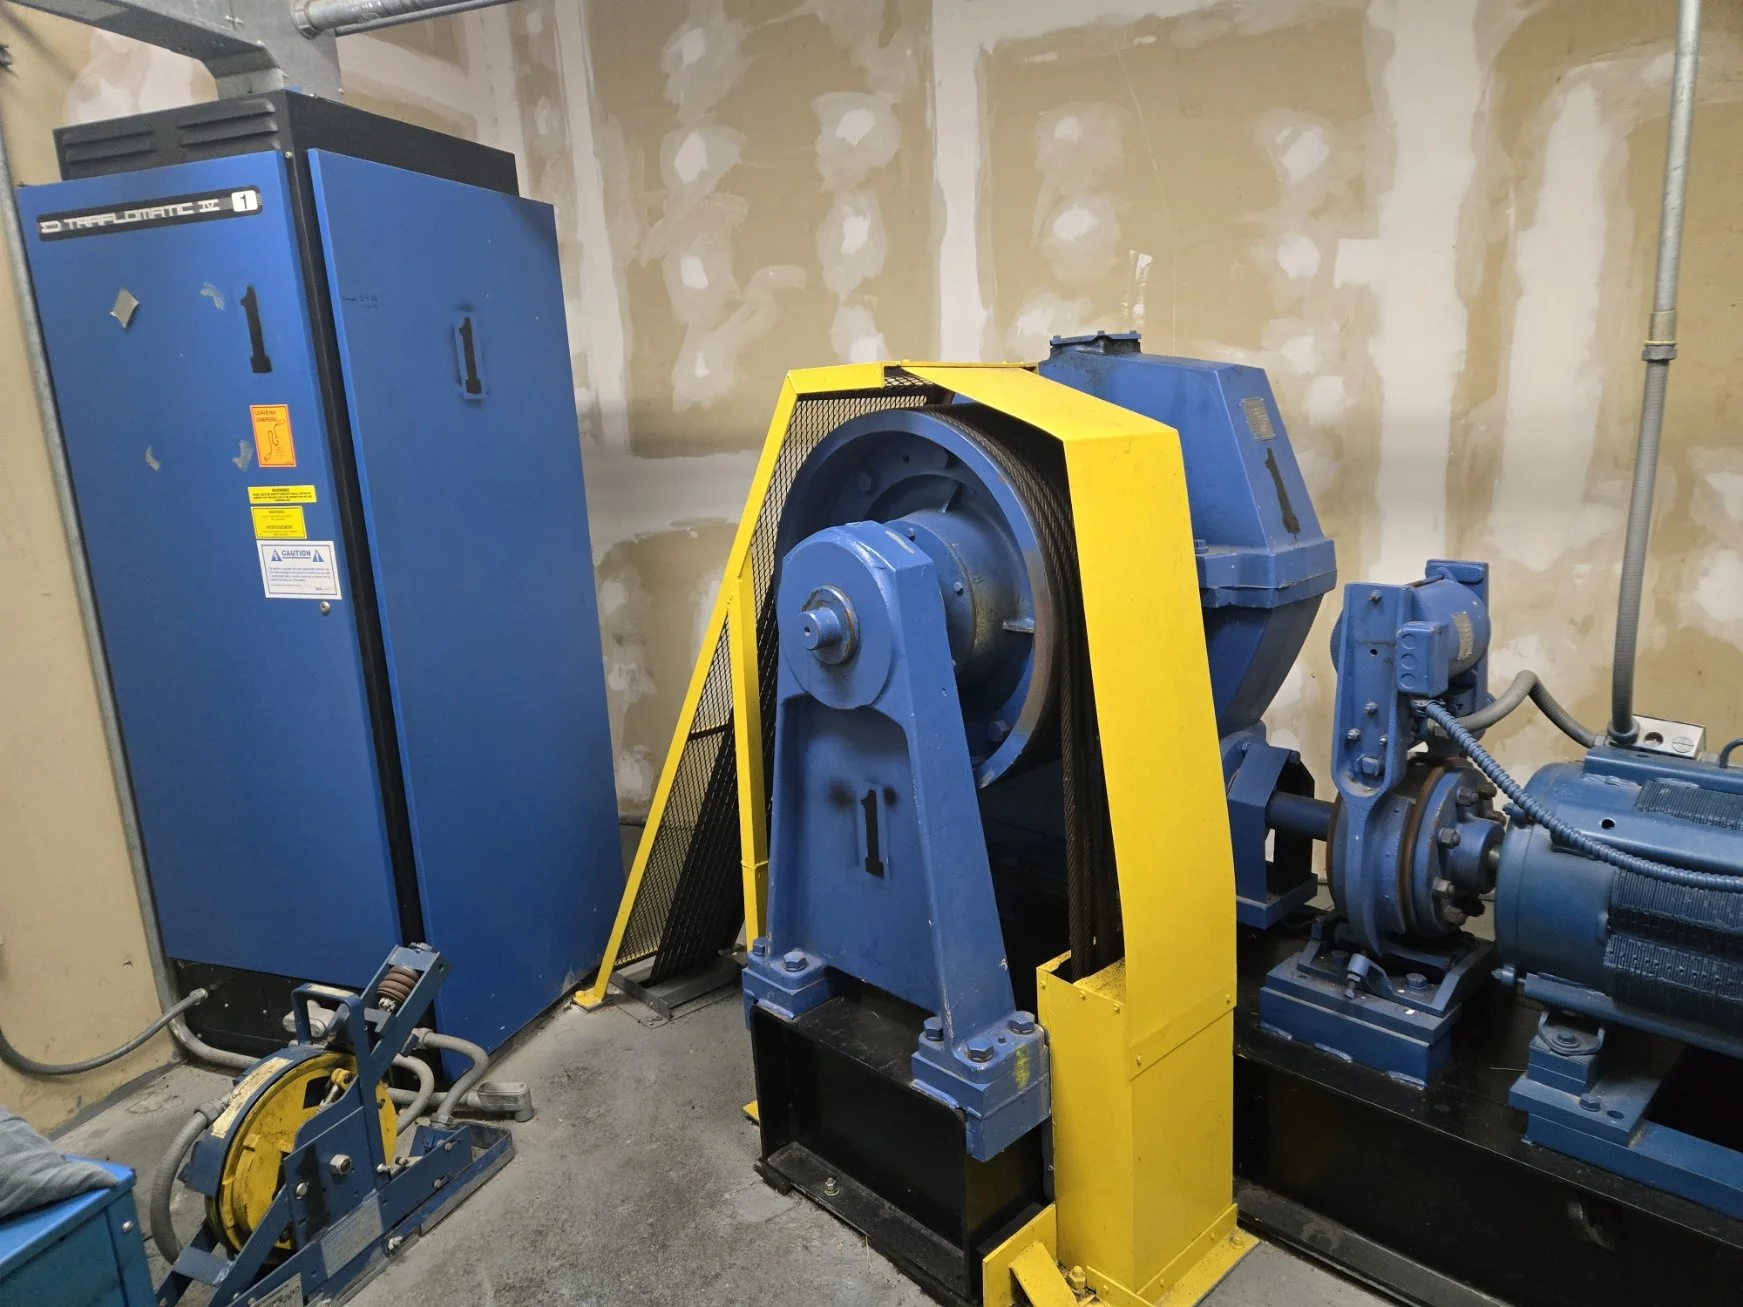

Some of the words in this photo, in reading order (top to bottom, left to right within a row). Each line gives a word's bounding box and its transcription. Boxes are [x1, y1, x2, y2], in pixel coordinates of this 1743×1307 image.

[64, 202, 193, 231] TRAFLOMATIC
[197, 198, 220, 213] IV
[281, 549, 312, 557] CAUTION
